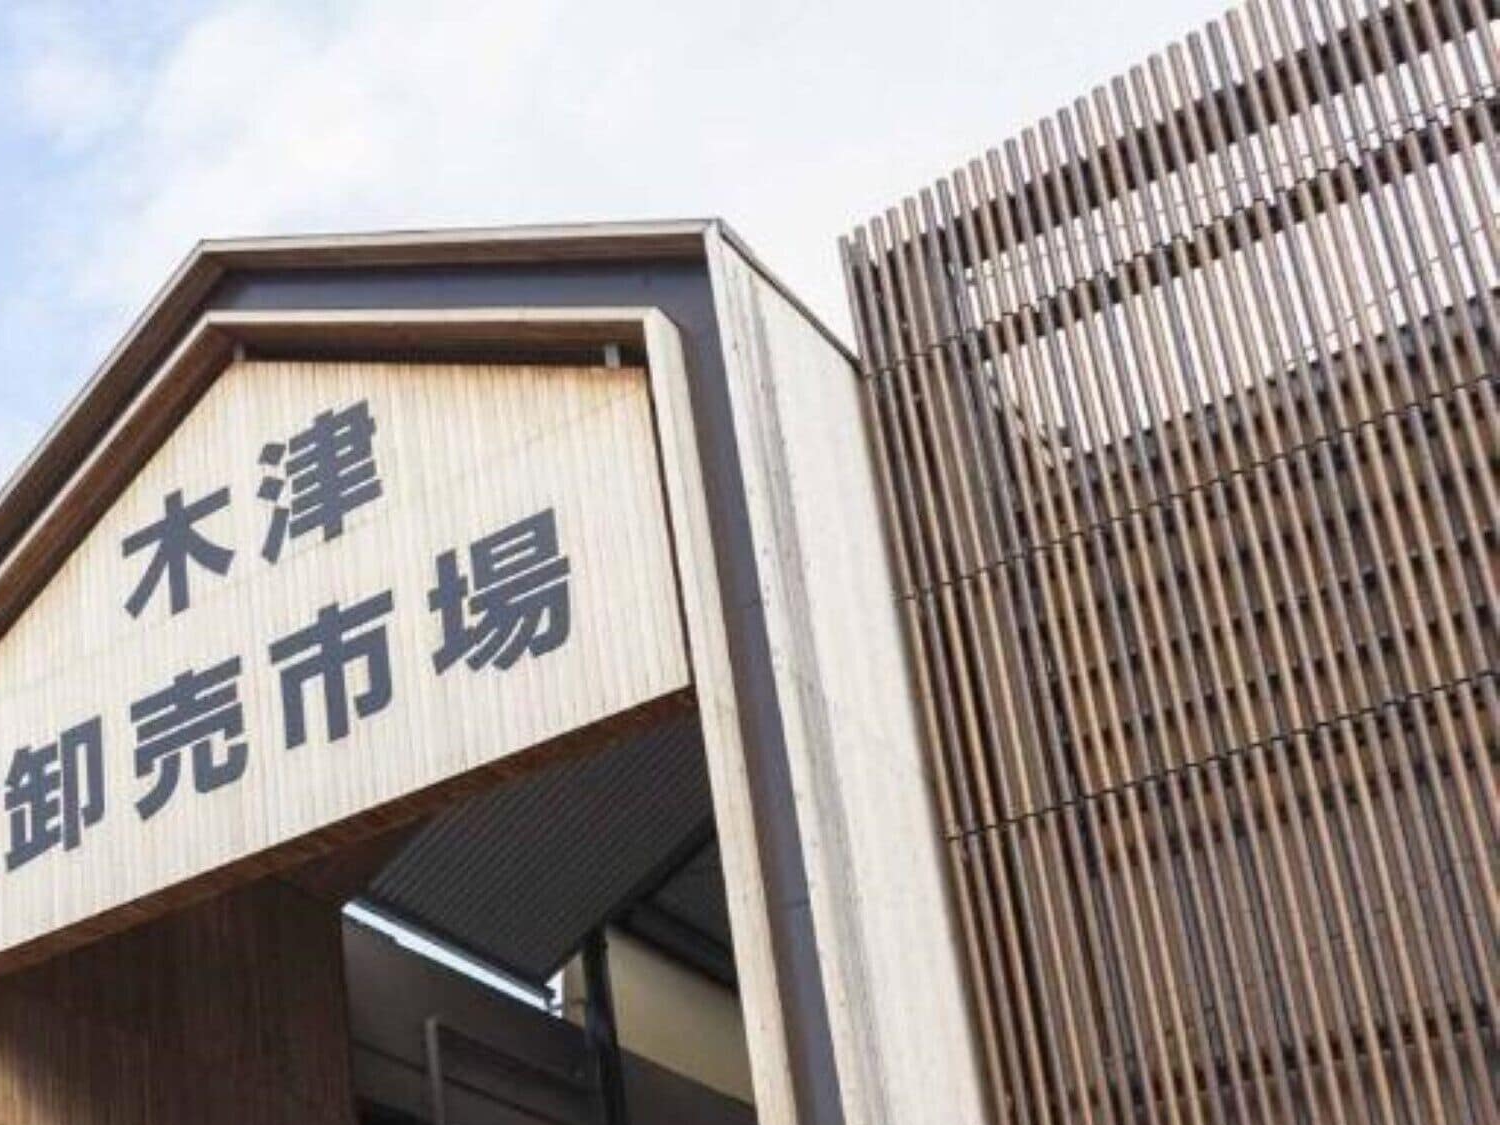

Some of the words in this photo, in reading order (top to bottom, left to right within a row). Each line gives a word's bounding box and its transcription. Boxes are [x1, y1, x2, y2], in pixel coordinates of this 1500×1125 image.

[122, 399, 383, 620] 木津
[3, 507, 573, 874] 卸売市場
